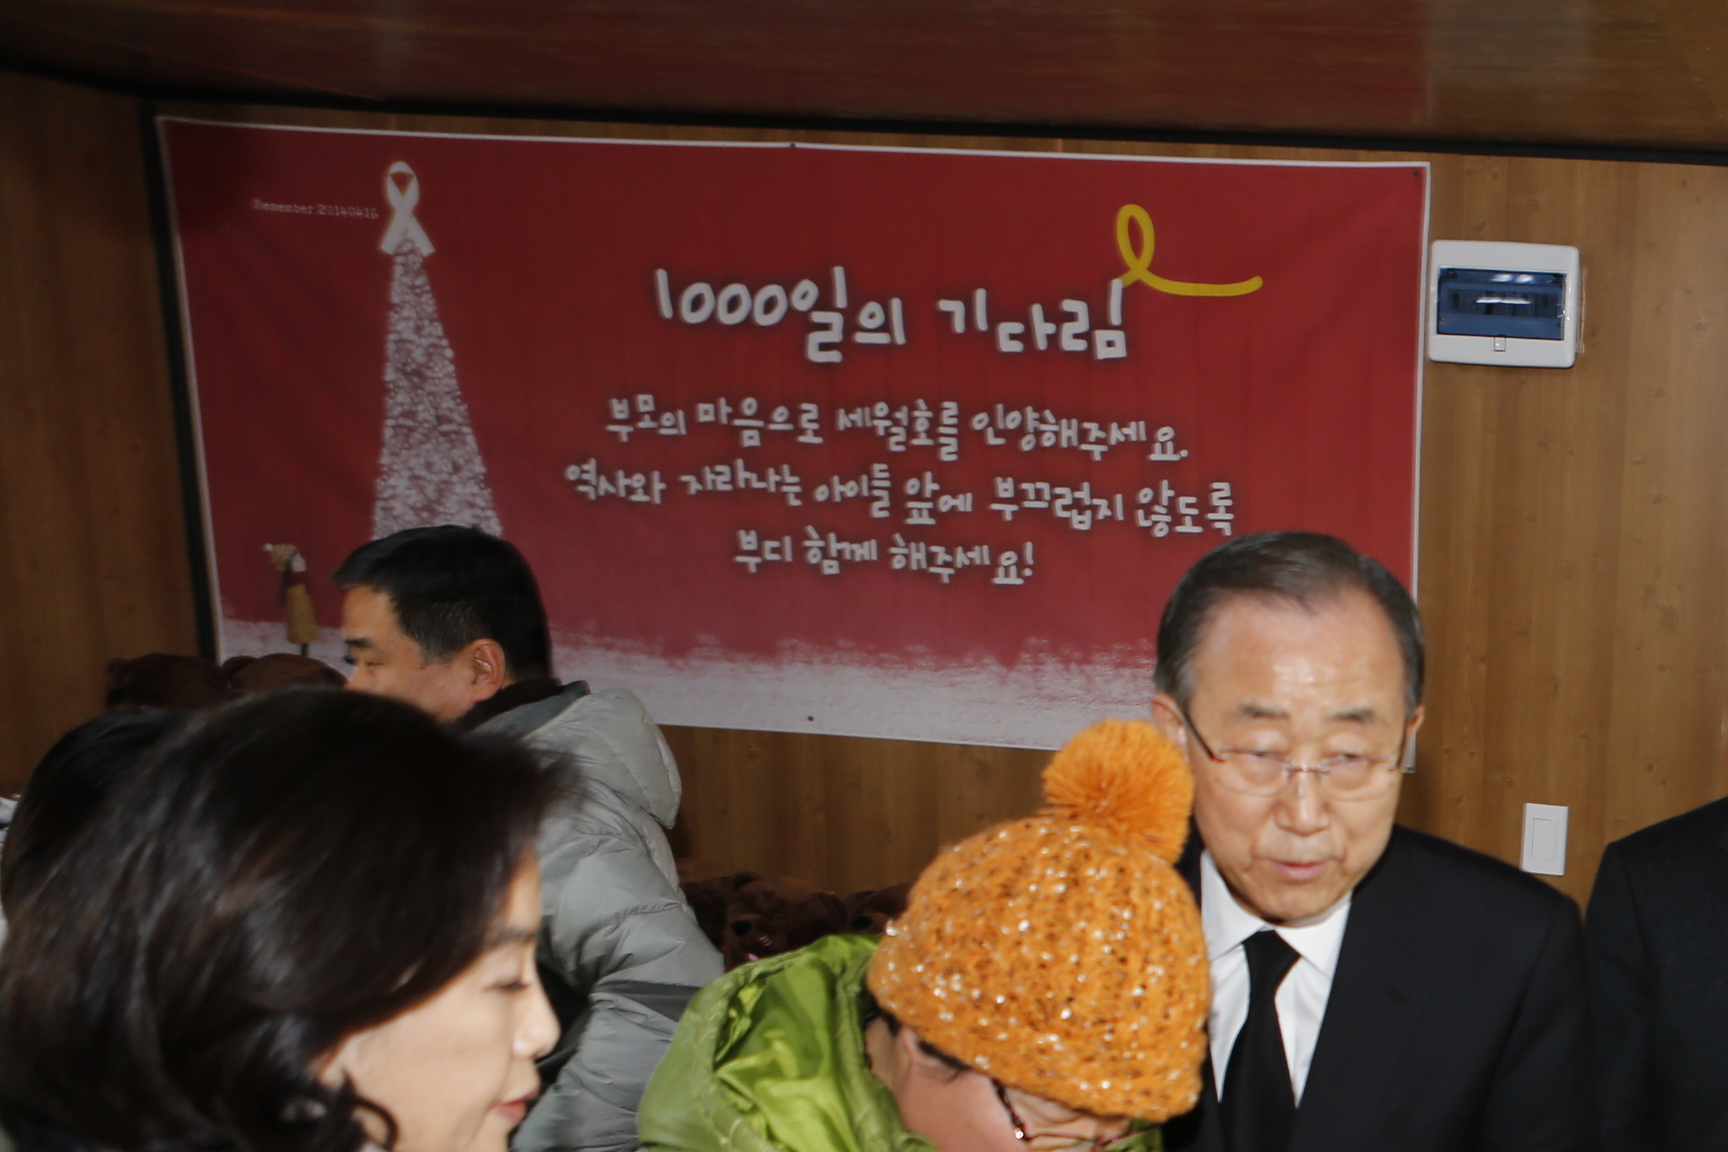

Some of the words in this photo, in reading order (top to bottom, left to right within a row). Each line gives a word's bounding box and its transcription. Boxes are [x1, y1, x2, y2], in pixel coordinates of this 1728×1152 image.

[252, 198, 314, 216] Remember
[317, 203, 379, 220] 20140416
[654, 266, 906, 364] 1000일의
[938, 278, 1127, 361] 기다림
[605, 394, 687, 442] 부모의
[696, 397, 823, 448] 마음으로
[836, 398, 959, 462] 세월호를
[565, 458, 667, 505] 역사와
[680, 458, 802, 507] 자라나는
[812, 463, 891, 519] 아이들
[904, 471, 973, 526] 앞에
[989, 477, 1125, 532] 부끄럽지
[1135, 479, 1236, 538] 않도록
[734, 529, 793, 574] 부디
[803, 525, 879, 576] 함께
